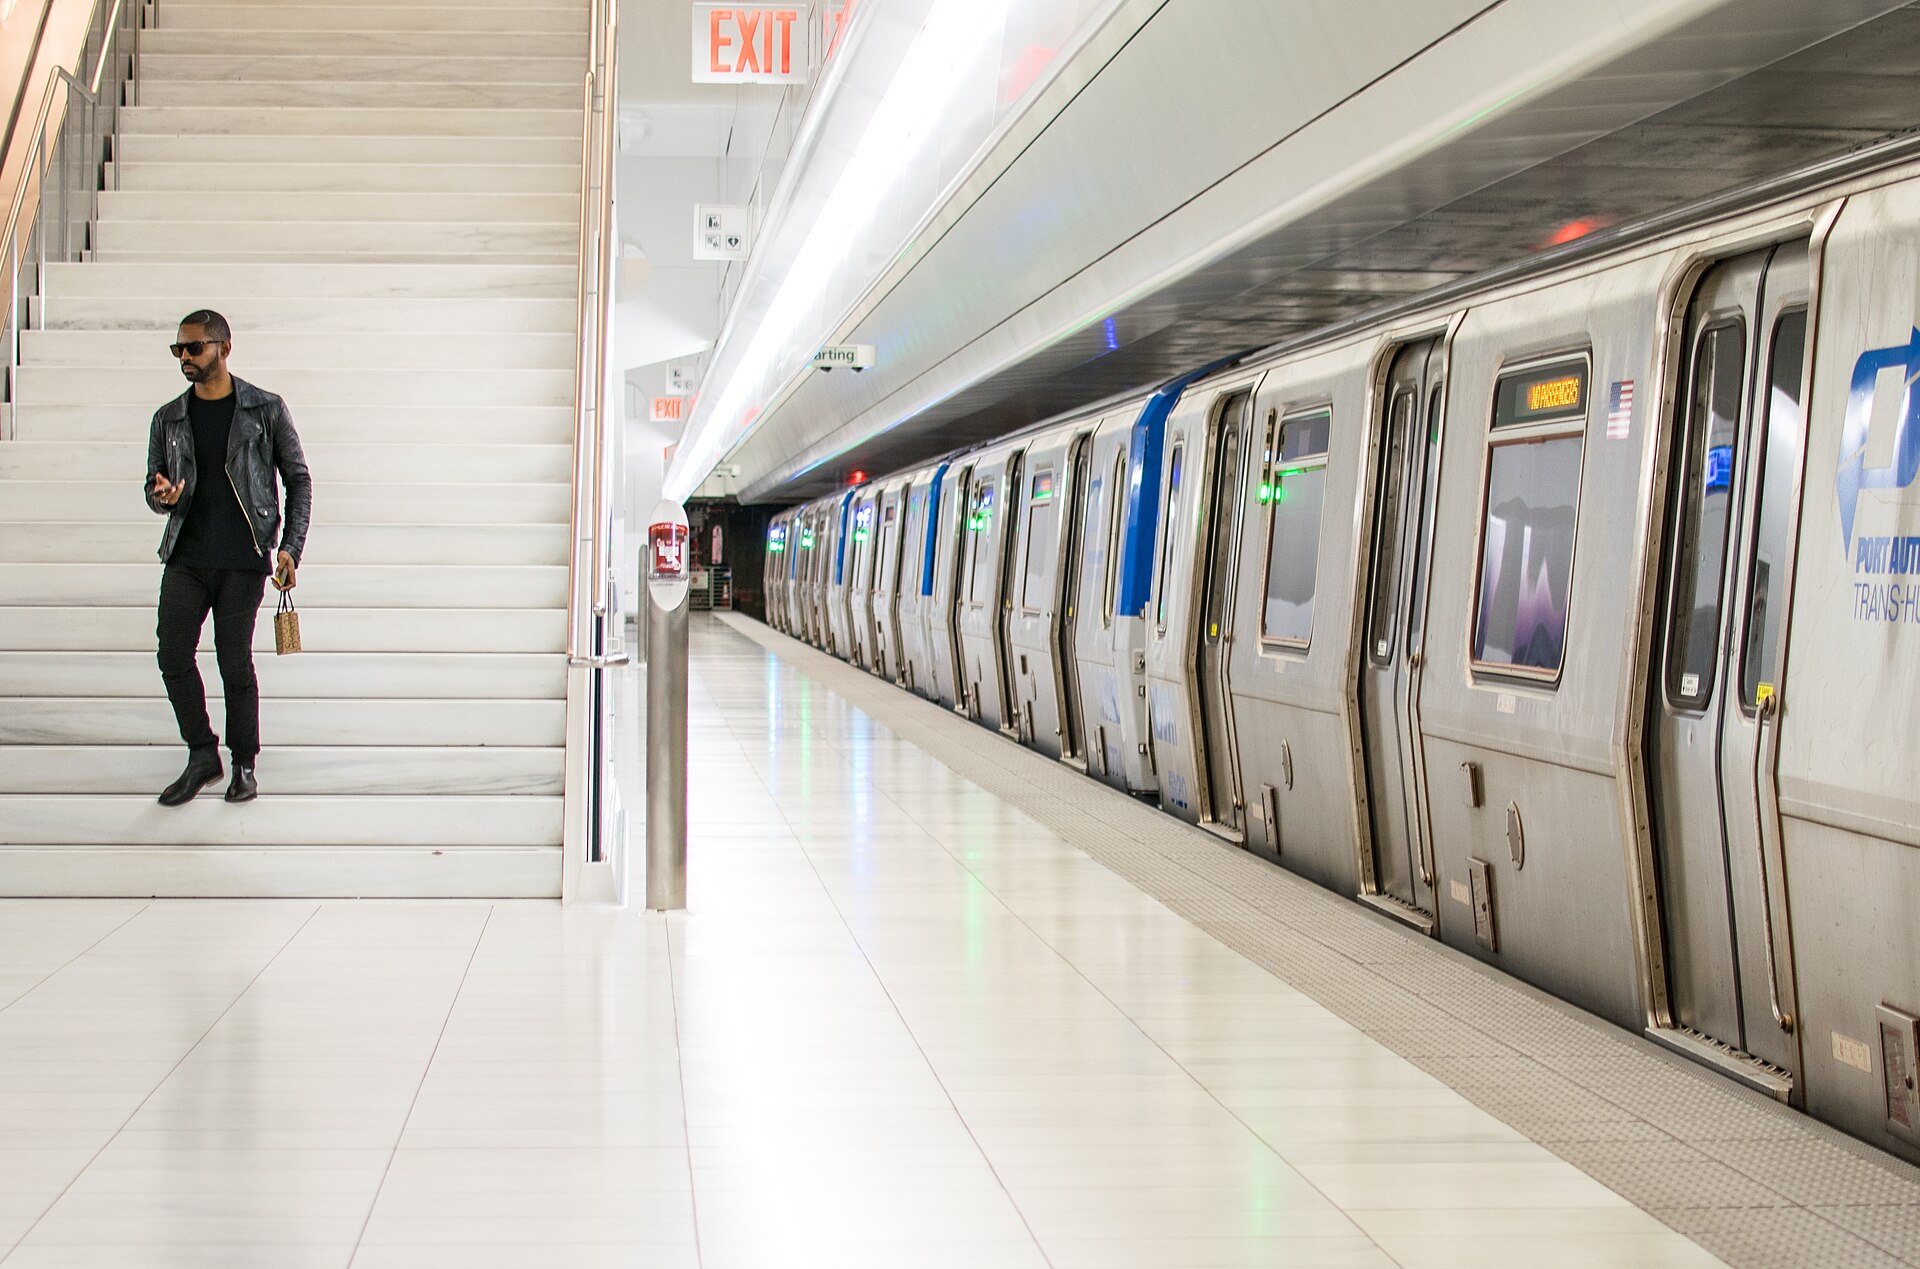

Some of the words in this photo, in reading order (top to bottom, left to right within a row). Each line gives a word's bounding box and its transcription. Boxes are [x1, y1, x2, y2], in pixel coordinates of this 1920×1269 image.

[710, 10, 797, 74] EXIT
[655, 398, 681, 418] EXIT
[1856, 536, 1890, 574] PORT
